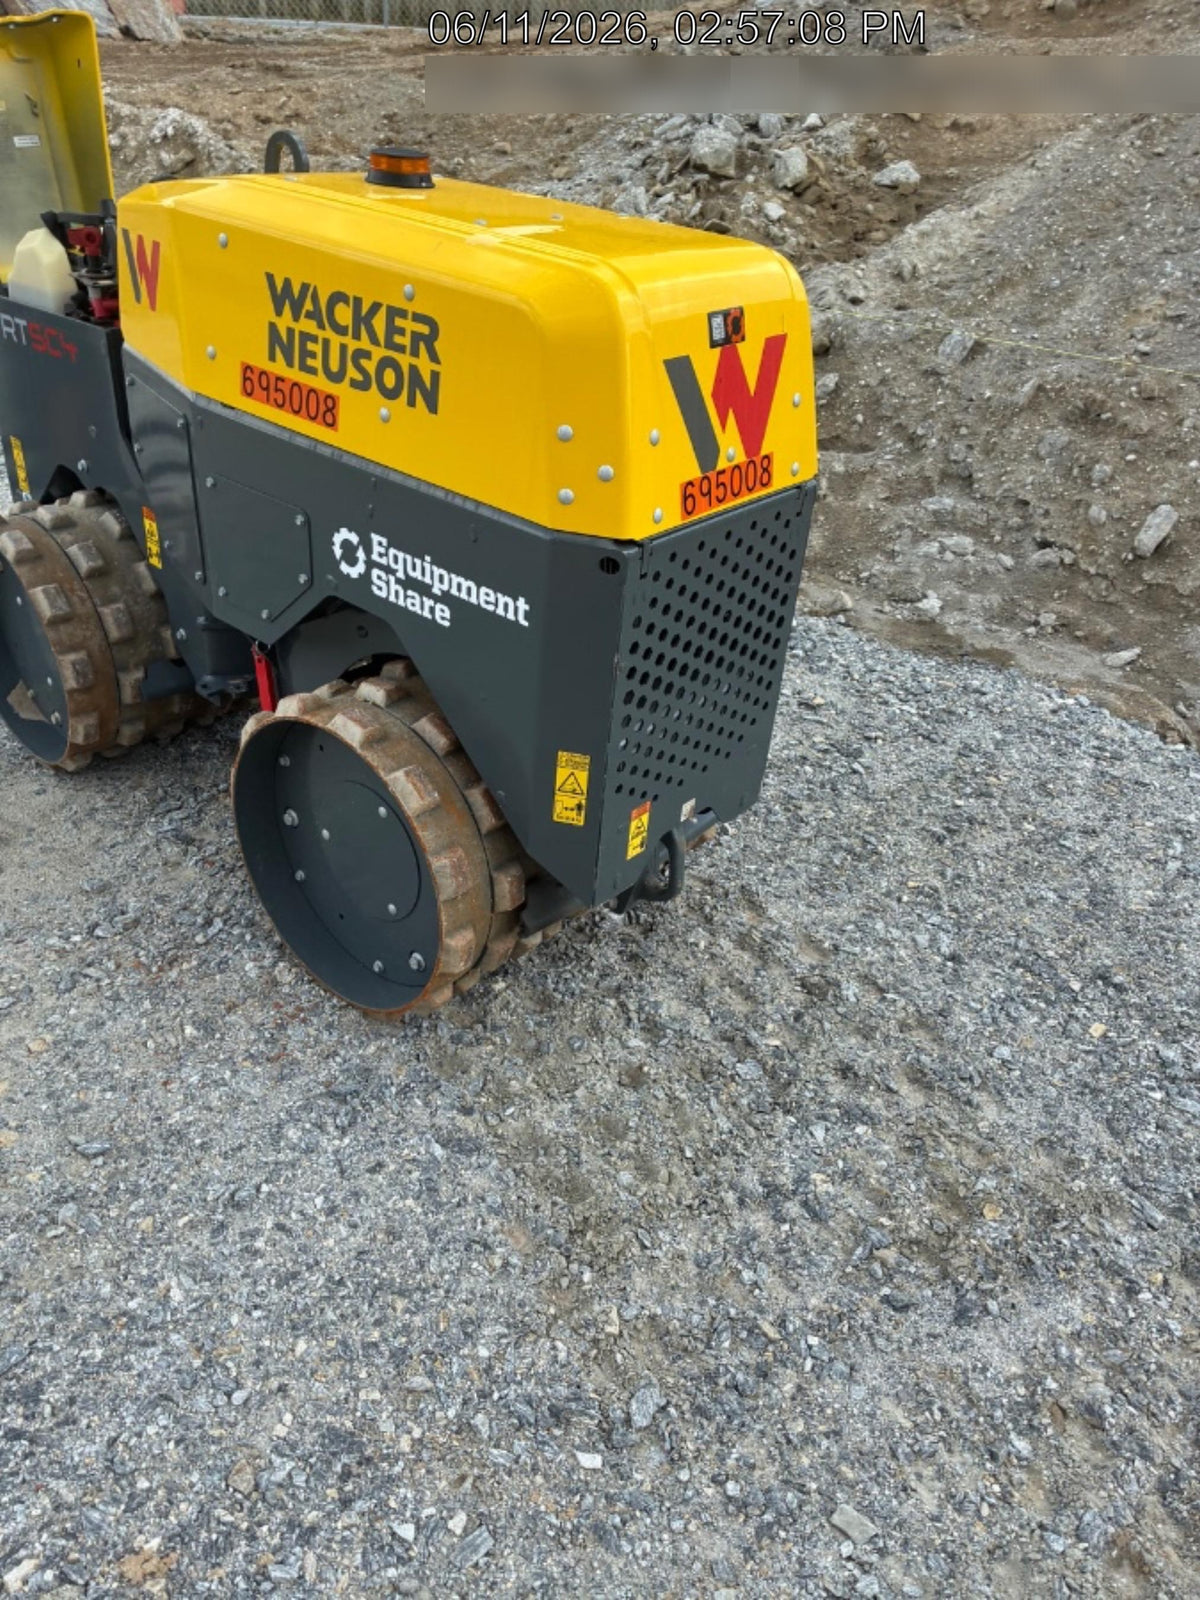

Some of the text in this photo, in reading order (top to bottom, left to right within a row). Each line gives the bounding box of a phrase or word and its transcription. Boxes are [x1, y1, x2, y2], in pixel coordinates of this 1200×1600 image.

[264, 271, 442, 366] WACKER
[242, 364, 338, 428] 695008
[267, 320, 442, 416] NEUSON
[682, 454, 773, 517] 695008
[370, 532, 531, 628] Equipment
[370, 567, 451, 628] Share
